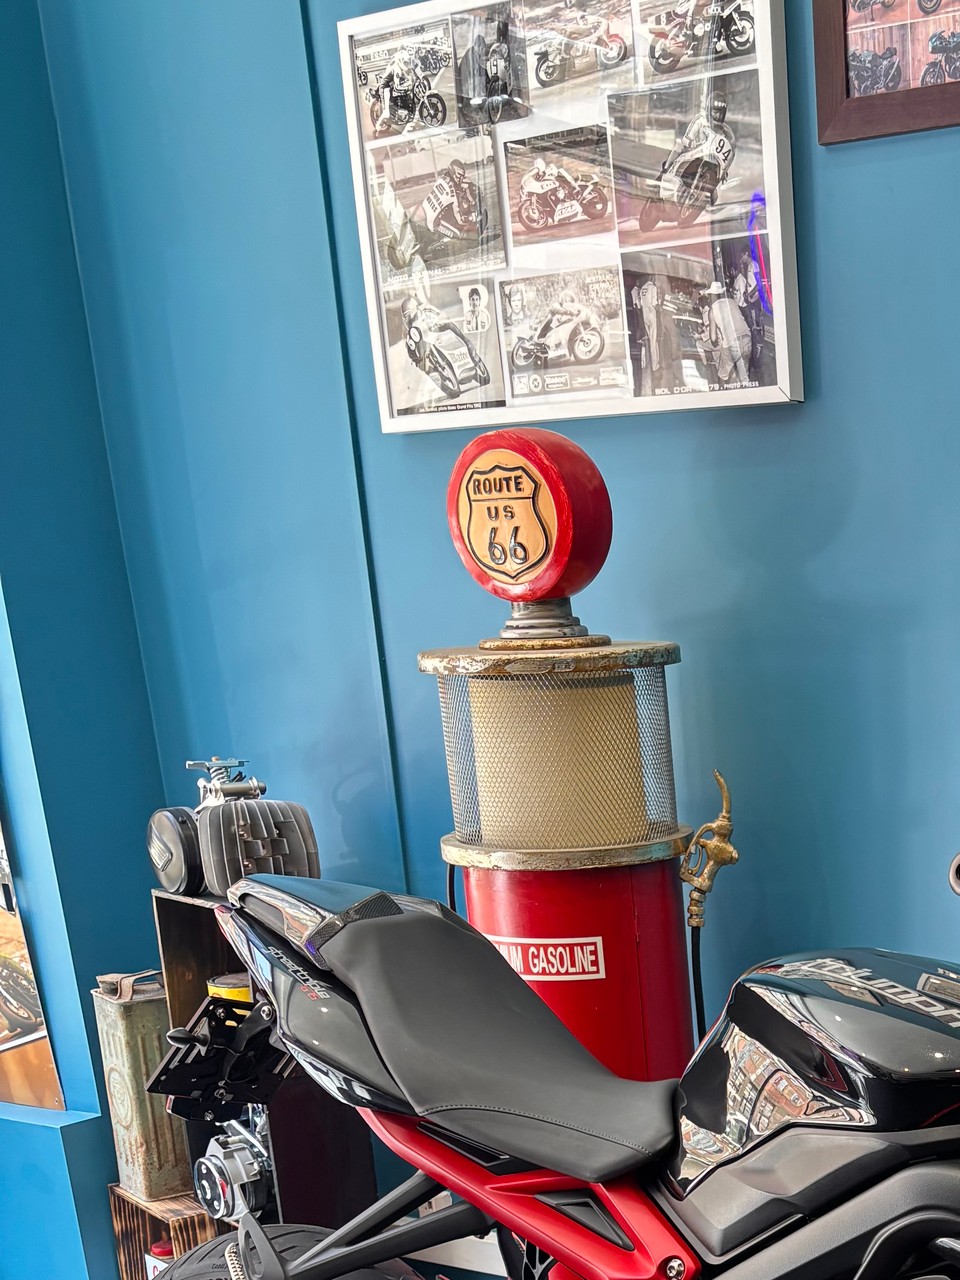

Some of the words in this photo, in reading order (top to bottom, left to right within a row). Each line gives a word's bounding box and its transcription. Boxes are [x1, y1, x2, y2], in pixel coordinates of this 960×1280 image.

[716, 138, 731, 163] 94
[473, 475, 524, 495] ROUTE
[486, 505, 515, 520] US
[488, 526, 529, 565] 66
[528, 945, 597, 974] GASOLINE
